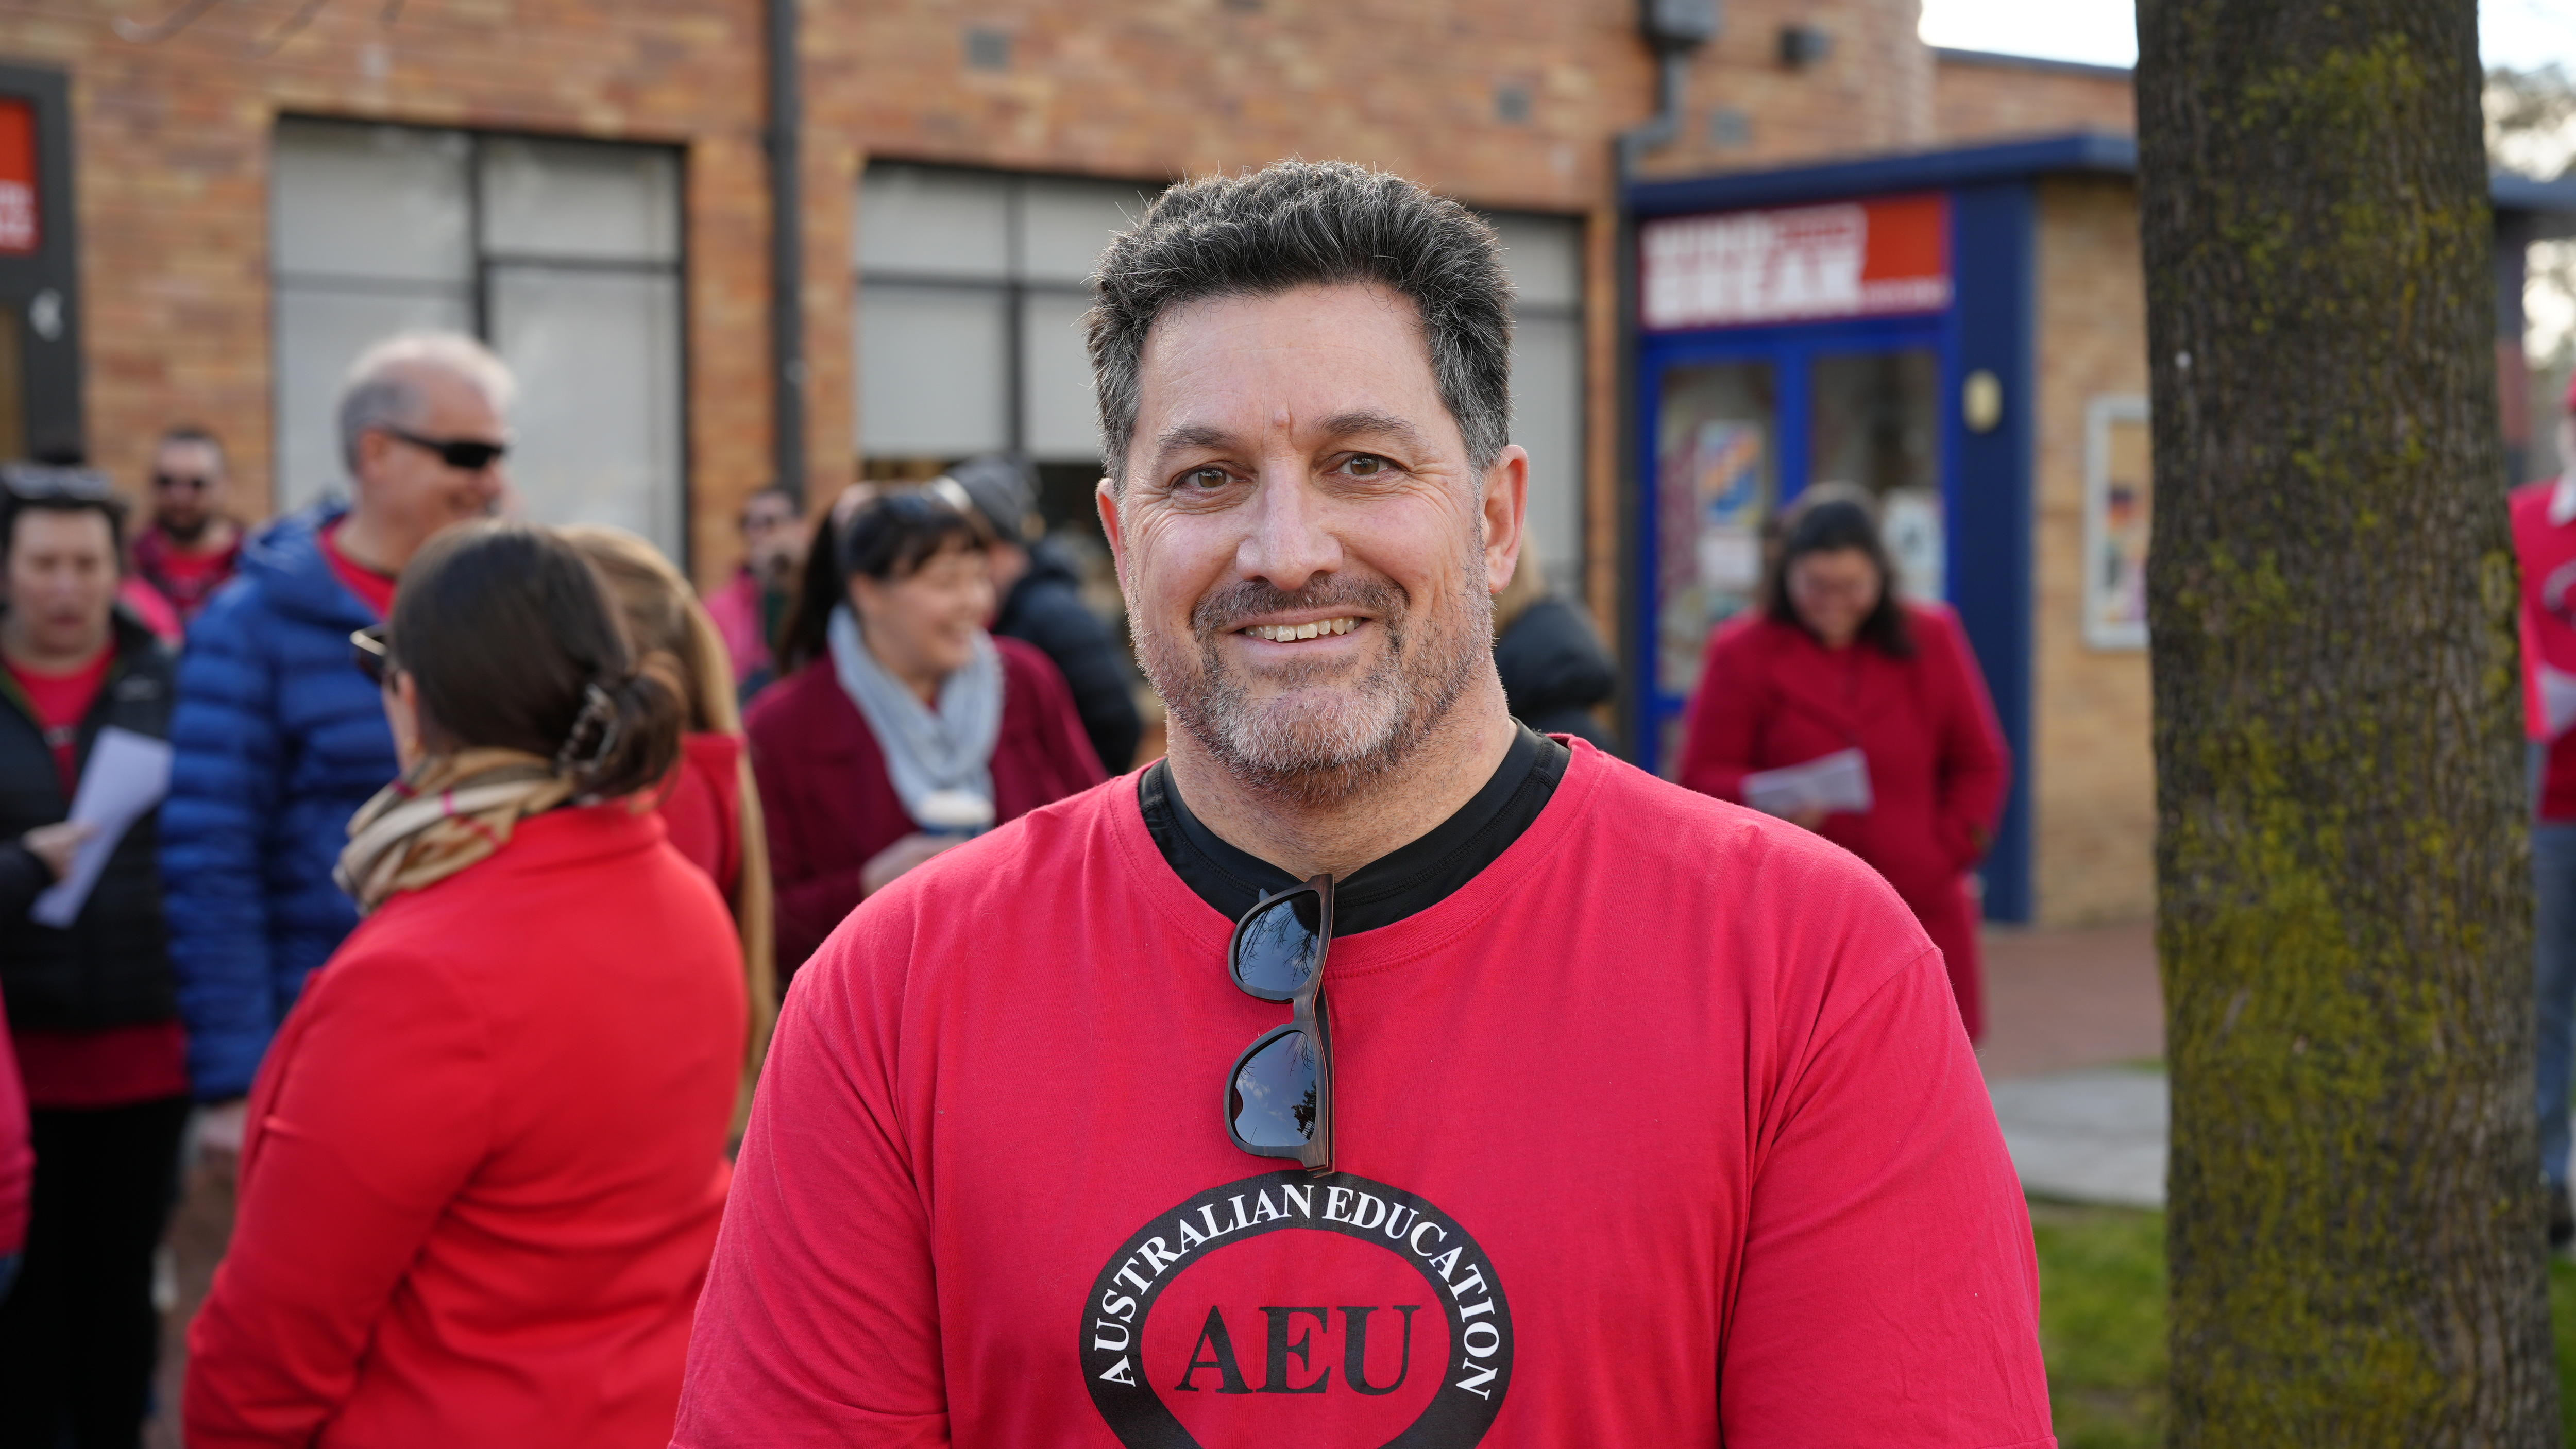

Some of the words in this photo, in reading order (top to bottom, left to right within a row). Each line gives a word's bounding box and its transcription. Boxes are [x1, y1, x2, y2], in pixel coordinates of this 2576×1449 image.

[1094, 1184, 1315, 1387] AUSTRALIAN
[1321, 1185, 1500, 1401] EDUCATION
[1174, 1305, 1420, 1396] AEU
